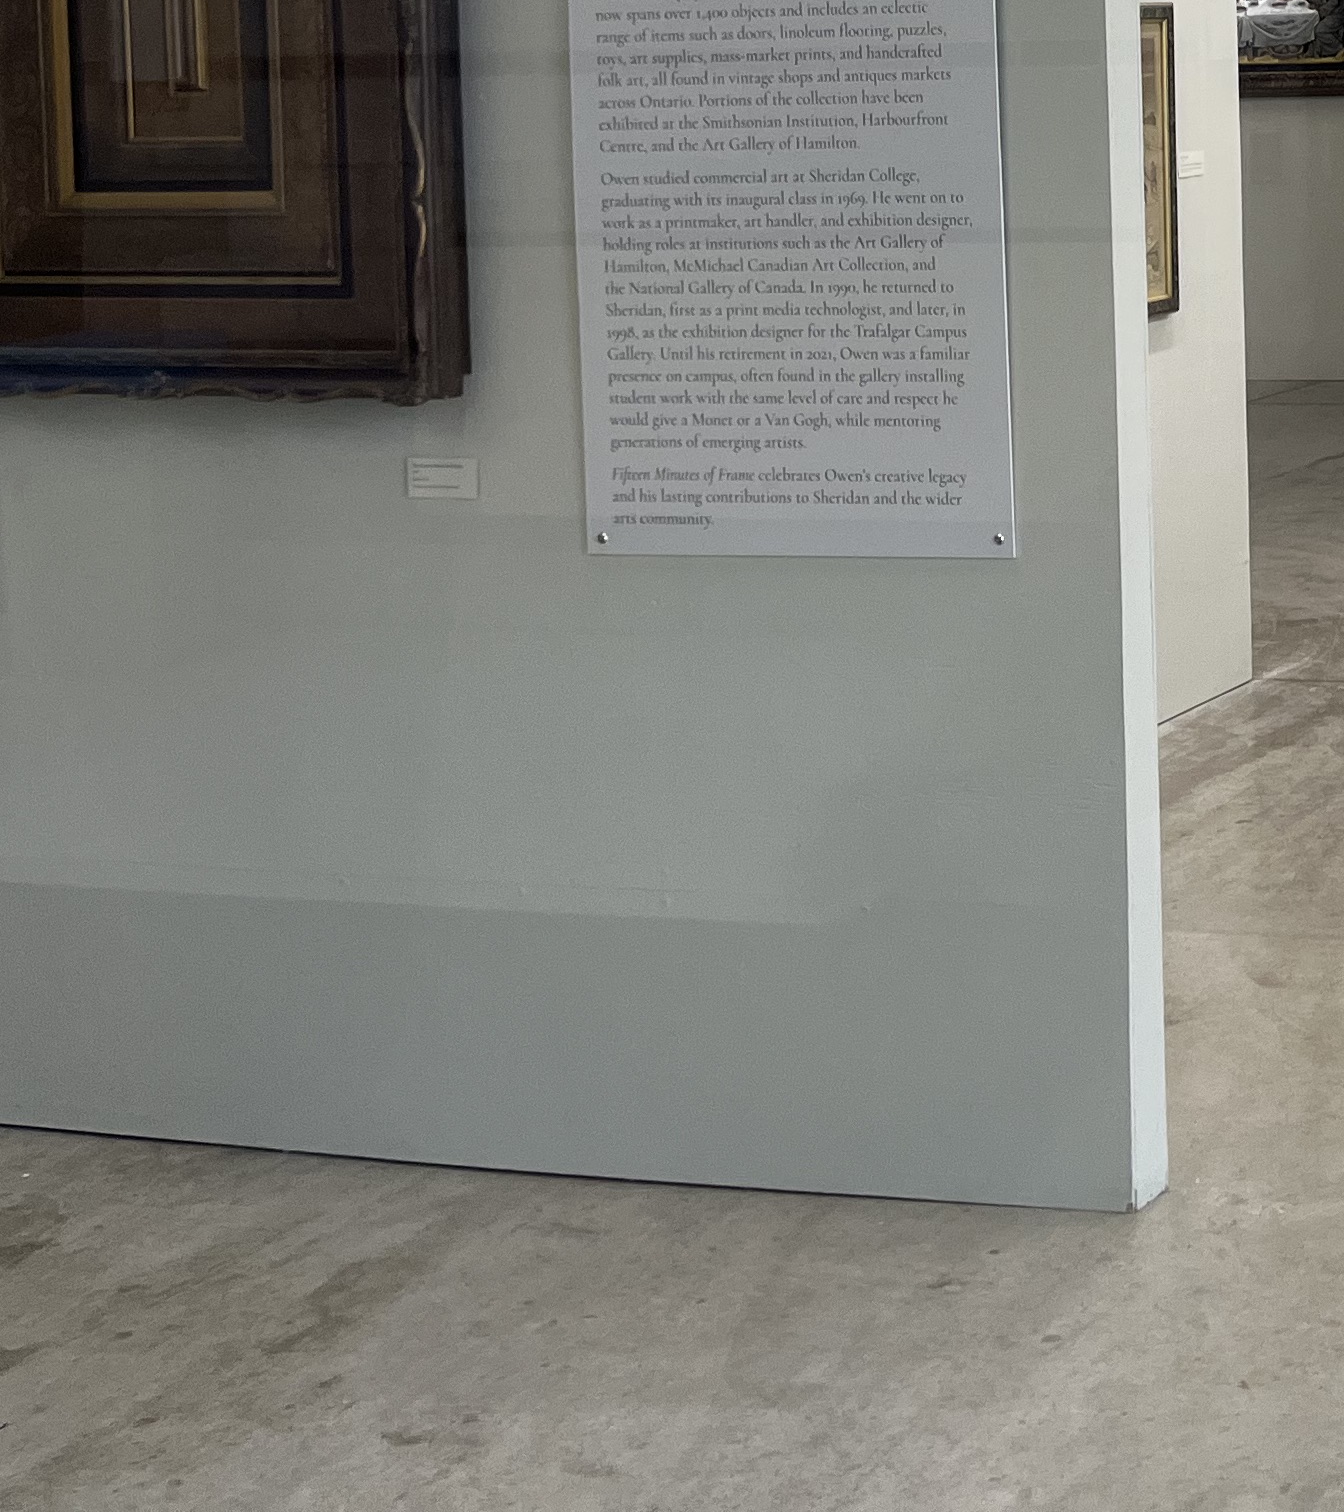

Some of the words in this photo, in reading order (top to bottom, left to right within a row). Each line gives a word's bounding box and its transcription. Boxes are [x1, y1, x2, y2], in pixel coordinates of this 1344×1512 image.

[778, 2, 803, 17] and
[806, 0, 859, 16] includes
[861, 4, 878, 15] an
[779, 23, 835, 39] linoleum
[838, 45, 863, 60] and
[865, 43, 943, 59] handcrafted
[728, 69, 775, 89] vintage
[777, 68, 813, 88] shops
[816, 67, 840, 83] and
[843, 66, 898, 86] antiques
[900, 65, 952, 81] markets
[771, 91, 792, 106] the
[795, 89, 858, 105] collection
[860, 88, 890, 104] have
[893, 88, 924, 103] been
[701, 113, 782, 129] Smithsonian
[861, 109, 948, 126] Harbourfront
[677, 136, 699, 152] the
[701, 136, 725, 151] Art
[727, 135, 775, 155] Gallery
[777, 134, 792, 150] of
[791, 170, 805, 183] at
[808, 167, 866, 183] Sheridan
[871, 188, 891, 204] He
[893, 191, 926, 203] went
[929, 192, 946, 203] on
[949, 190, 964, 203] to
[820, 211, 845, 227] and
[846, 210, 913, 226] exhibition
[673, 258, 744, 274] McMichael
[746, 257, 808, 273] Canadian
[811, 257, 834, 272] Art
[911, 256, 936, 271] and
[809, 279, 824, 294] In
[862, 278, 878, 293] he
[880, 278, 937, 293] returned
[939, 280, 955, 293] to
[725, 301, 759, 321] print
[761, 301, 801, 316] media
[888, 300, 913, 315] and
[749, 323, 804, 342] designer
[806, 323, 826, 338] for
[829, 322, 851, 338] the
[853, 322, 911, 342] Trafalgar
[913, 322, 968, 342] Campus
[789, 345, 803, 360] in
[839, 344, 879, 360] Owen
[881, 349, 906, 360] was
[919, 344, 970, 360] familiar
[776, 367, 815, 382] found
[818, 367, 832, 382] in
[834, 367, 856, 382] the
[858, 367, 901, 386] gallery
[904, 366, 965, 386] installing
[865, 389, 891, 404] and
[893, 392, 939, 409] respect
[942, 389, 958, 404] he
[764, 412, 790, 427] Van
[834, 412, 870, 427] while
[872, 412, 941, 431] mentoring
[701, 433, 761, 452] emerging
[873, 467, 925, 482] creative
[927, 467, 967, 486] legacy
[812, 489, 870, 504] Sheridan
[872, 489, 898, 504] and
[900, 489, 922, 505] the
[924, 489, 962, 505] wider
